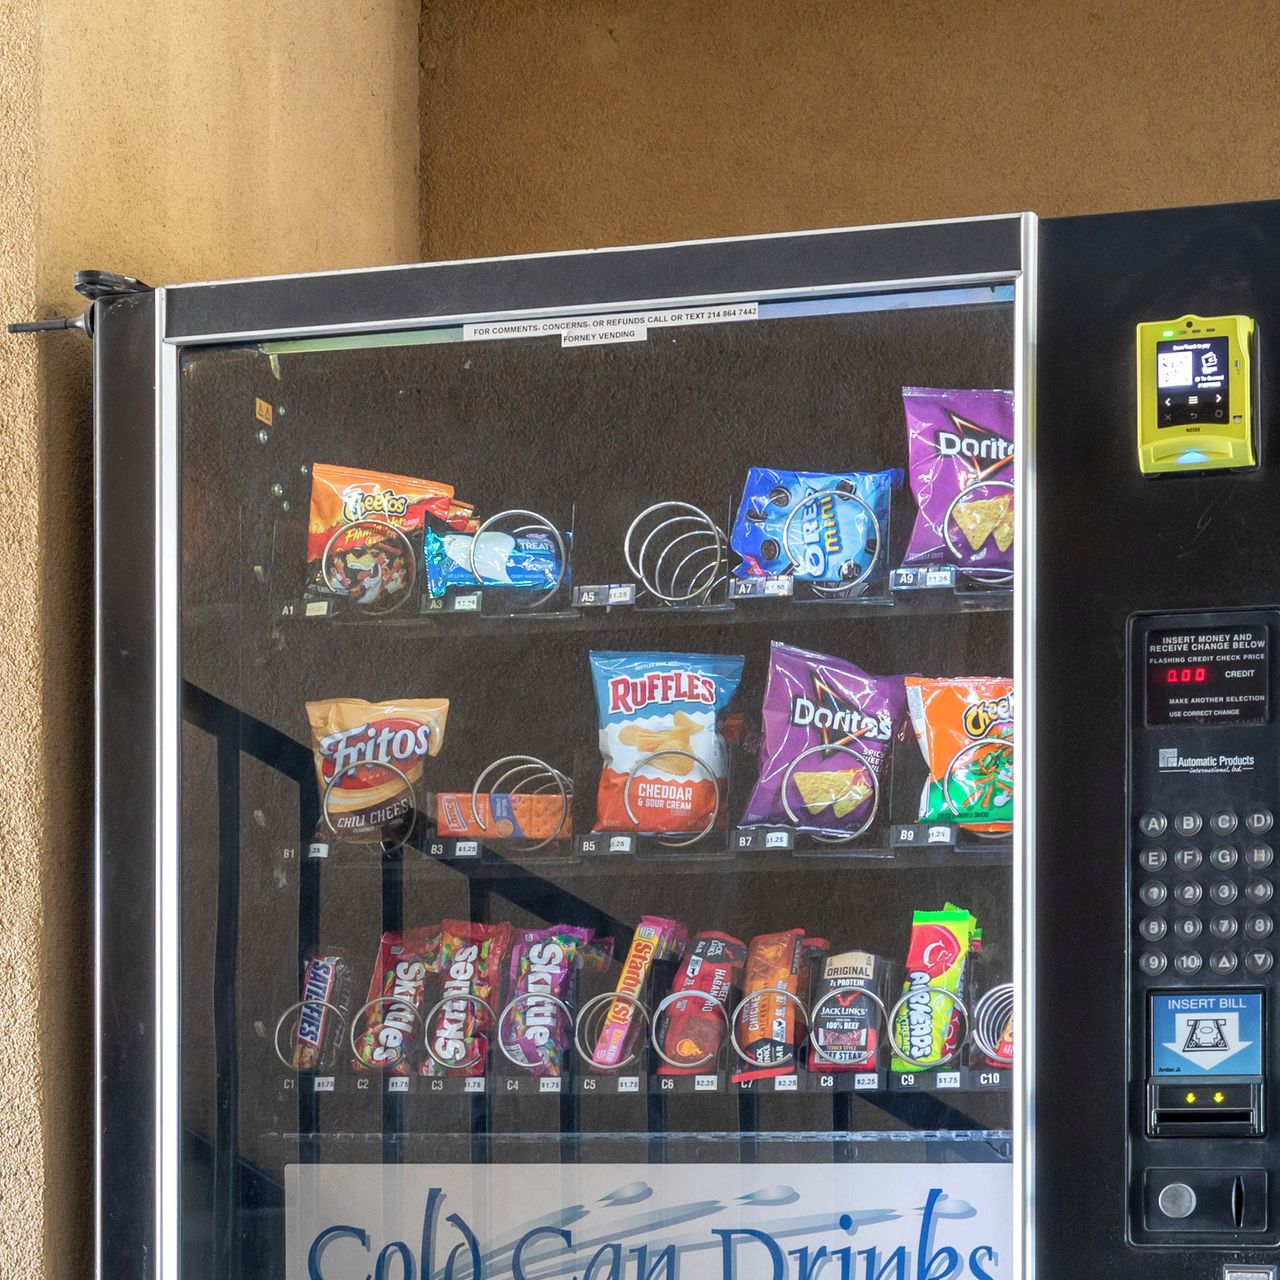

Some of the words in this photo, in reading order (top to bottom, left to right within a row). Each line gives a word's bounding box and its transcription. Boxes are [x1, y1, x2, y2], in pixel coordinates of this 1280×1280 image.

[473, 327, 491, 336] FOR
[592, 320, 605, 328] OR
[606, 317, 645, 327] REFUNDS
[648, 315, 669, 324] CALL
[671, 313, 683, 322] OR
[685, 312, 706, 321] TEXT
[707, 310, 721, 319] 214
[723, 309, 737, 317] 864
[738, 307, 757, 316] 7442
[563, 333, 596, 343] FORNEY
[599, 330, 636, 340] VENDING
[818, 496, 840, 553] mini
[899, 573, 914, 584] A9
[738, 583, 752, 594] A7
[582, 592, 595, 602] A5
[430, 600, 443, 609] A3
[1162, 635, 1195, 644] INSERT
[1198, 634, 1231, 643] MONEY
[1233, 633, 1252, 641] AND
[1149, 644, 1189, 653] RECEIVE
[1191, 642, 1230, 651] CHANGE
[1232, 640, 1266, 649] BELOW
[1225, 669, 1255, 678] CREDIT
[610, 672, 715, 713] RUFFLES
[1190, 696, 1224, 704] ANOTHER
[794, 698, 892, 740] Doritos
[320, 722, 431, 786] Fritos
[1178, 756, 1217, 767] Automatic
[1219, 755, 1254, 766] Products
[638, 783, 693, 800] CHEDDAR
[638, 799, 643, 807] &
[645, 799, 664, 808] SOUR
[666, 801, 692, 810] CREAM
[337, 815, 365, 828] CHILI
[1148, 818, 1160, 831] A
[1182, 816, 1194, 830] B
[1218, 815, 1230, 829] C
[1253, 814, 1265, 827] D
[900, 830, 914, 840] B9
[583, 841, 596, 851] B5
[739, 836, 752, 847] B7
[283, 849, 295, 859] B1
[431, 844, 443, 855] B3
[1254, 849, 1266, 862] H
[1148, 852, 1159, 865] E
[1184, 851, 1194, 864] F
[1218, 850, 1230, 863] G
[1183, 886, 1194, 899] 2
[1219, 884, 1230, 898] 3
[1254, 884, 1266, 897] 4
[1149, 921, 1159, 934] 5
[1183, 920, 1194, 934] 6
[1219, 920, 1229, 933] 7
[1254, 919, 1265, 932] 8
[1149, 956, 1159, 969] 9
[1180, 955, 1197, 969] 10
[827, 966, 870, 977] ORIGINAL
[837, 979, 865, 987] PROTEIN
[702, 968, 727, 1013] HABANRO
[435, 945, 479, 1061] Skittles
[1168, 998, 1216, 1010] INSERT
[1219, 998, 1247, 1009] BILL
[748, 993, 761, 1032] CHICKE
[820, 1007, 841, 1015] JACK
[826, 1021, 843, 1030] 100%
[843, 1021, 860, 1030] BEEF
[283, 1079, 295, 1089] C1
[357, 1079, 369, 1090] C2
[391, 1081, 409, 1089] $1.75
[431, 1080, 443, 1090] C3
[506, 1080, 519, 1090] C4
[541, 1081, 560, 1089] $1.75
[584, 1079, 596, 1089] C5
[619, 1080, 639, 1089] $1.75
[661, 1079, 674, 1090] C6
[696, 1079, 715, 1087] $2.25
[821, 1076, 834, 1087] C8
[901, 1074, 915, 1086] C9
[938, 1076, 958, 1084] $1.75
[980, 1073, 1000, 1085] C10
